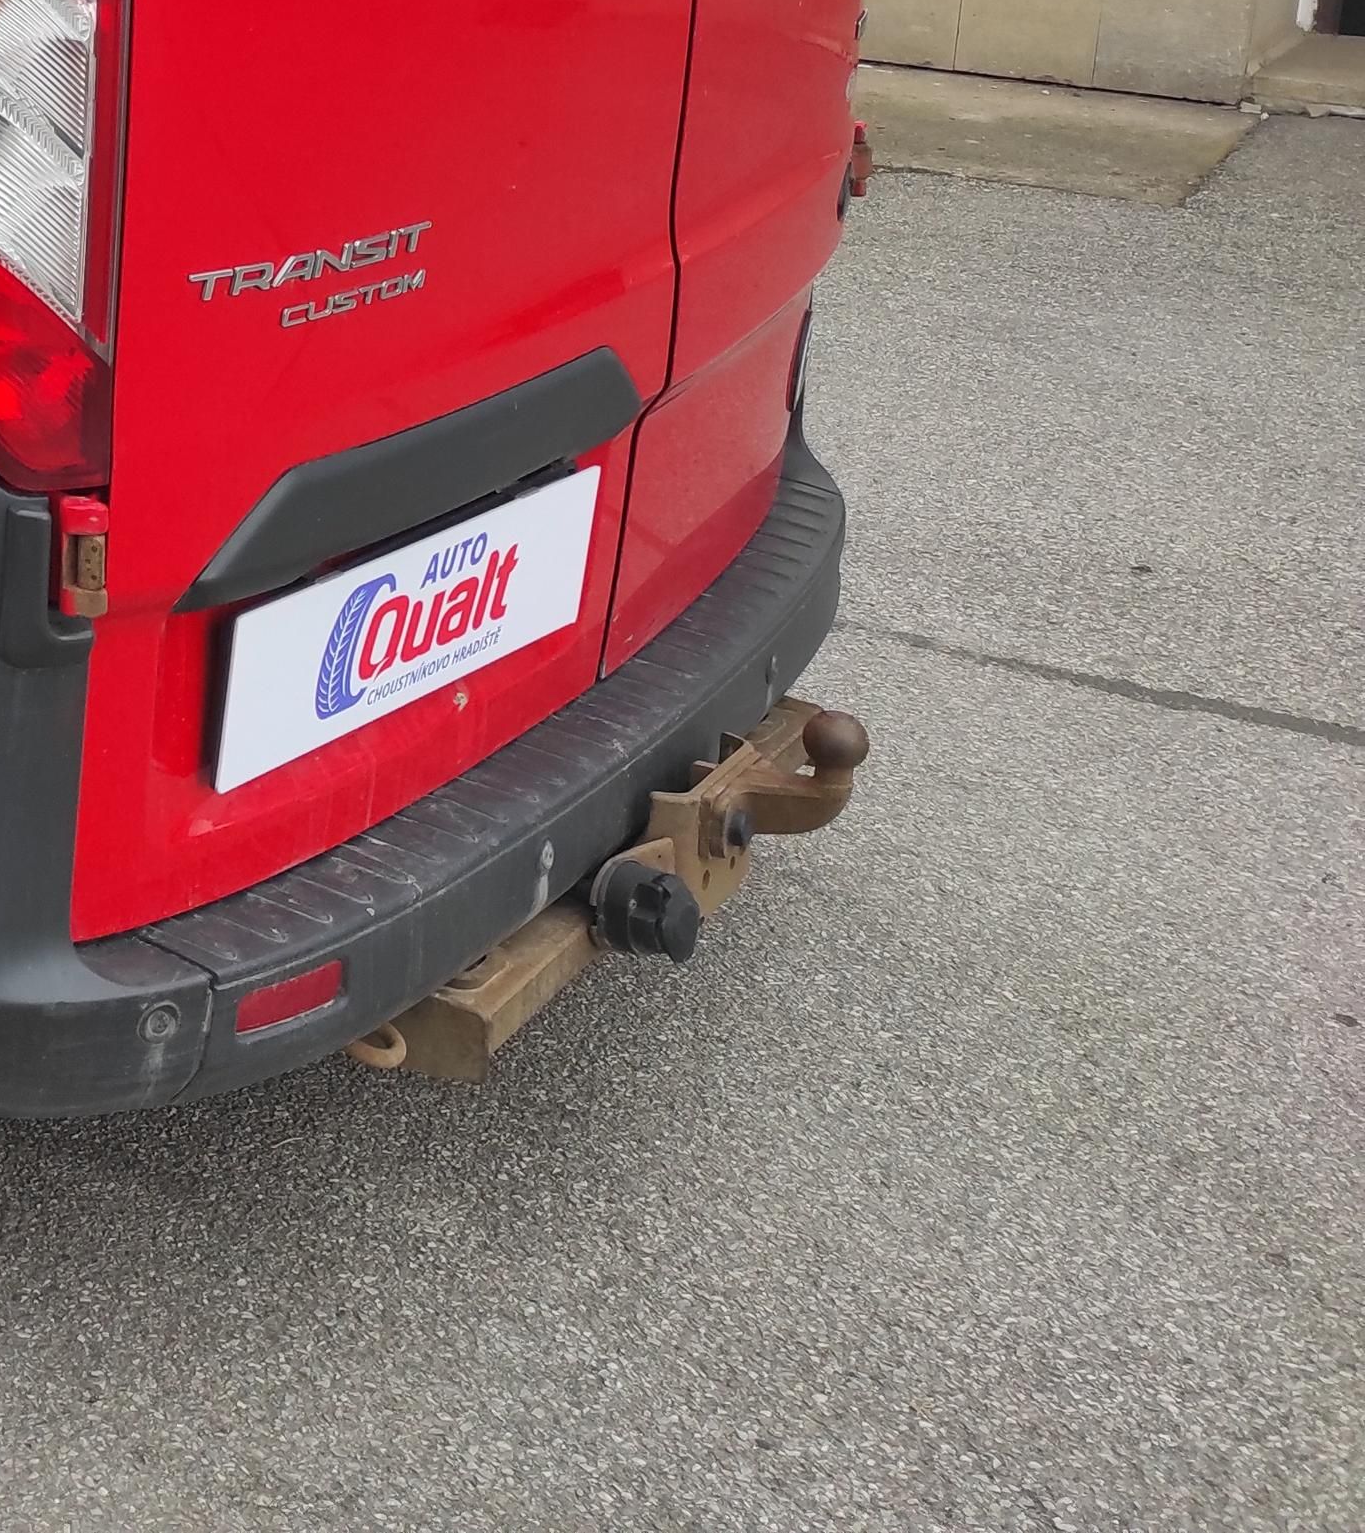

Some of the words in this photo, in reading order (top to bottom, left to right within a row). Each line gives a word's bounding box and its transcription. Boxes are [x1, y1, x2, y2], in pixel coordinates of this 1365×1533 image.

[188, 220, 433, 302] TRANSIT
[280, 269, 426, 328] CUSTOM
[420, 531, 489, 589] AUTO
[366, 654, 452, 706] CHOUSTNÍKOVO
[451, 626, 503, 665] HRADIŠTĚ
